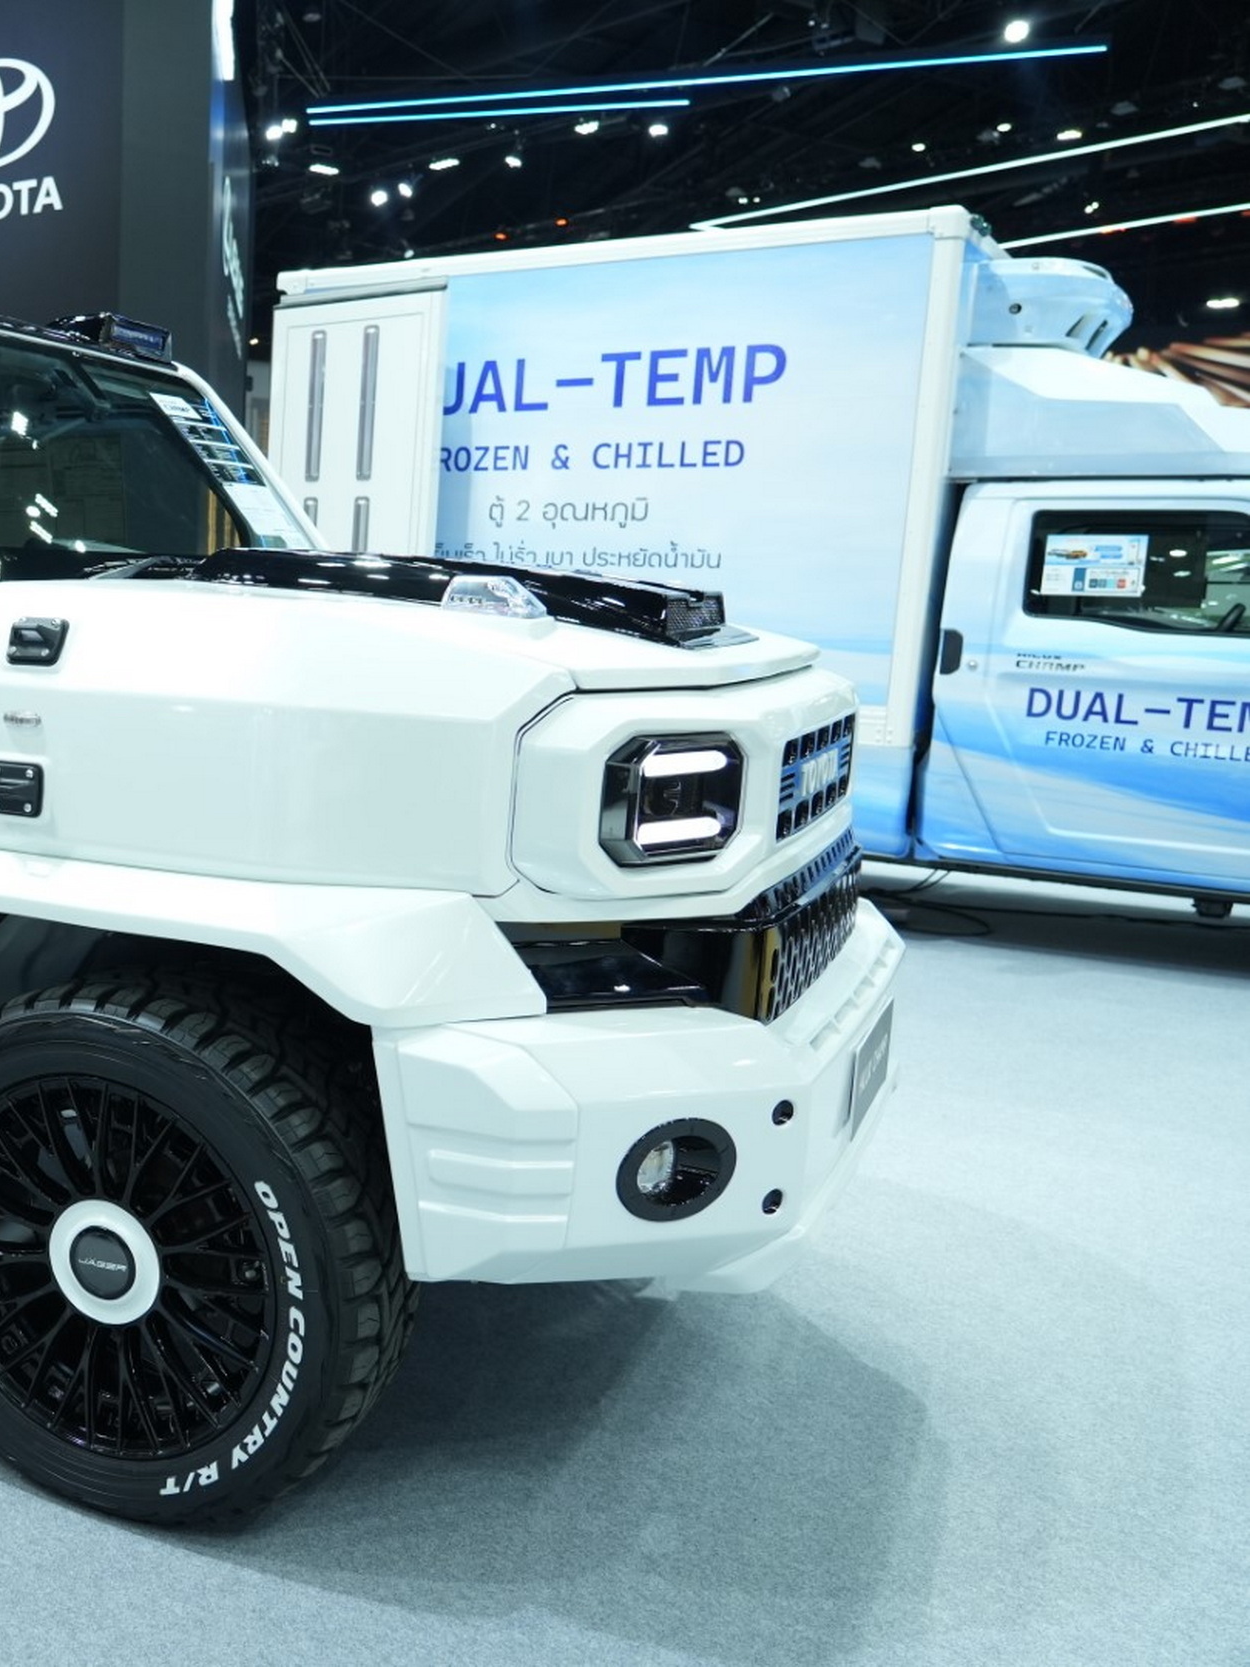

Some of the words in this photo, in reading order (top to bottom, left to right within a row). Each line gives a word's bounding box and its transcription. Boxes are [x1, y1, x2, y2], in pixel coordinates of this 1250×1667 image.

[551, 444, 570, 470] &
[592, 440, 746, 469] CHILLED
[488, 495, 505, 528] ตู้
[517, 499, 530, 522] 2
[542, 497, 649, 528] อุณหภูมิ
[582, 541, 721, 569] ประหยัดน้ำมัน
[1045, 731, 1126, 751] FROZEN
[1140, 739, 1154, 754] &
[254, 1180, 304, 1300] OPEN
[230, 1306, 306, 1470] COUNTRY
[159, 1460, 219, 1496] R/T
